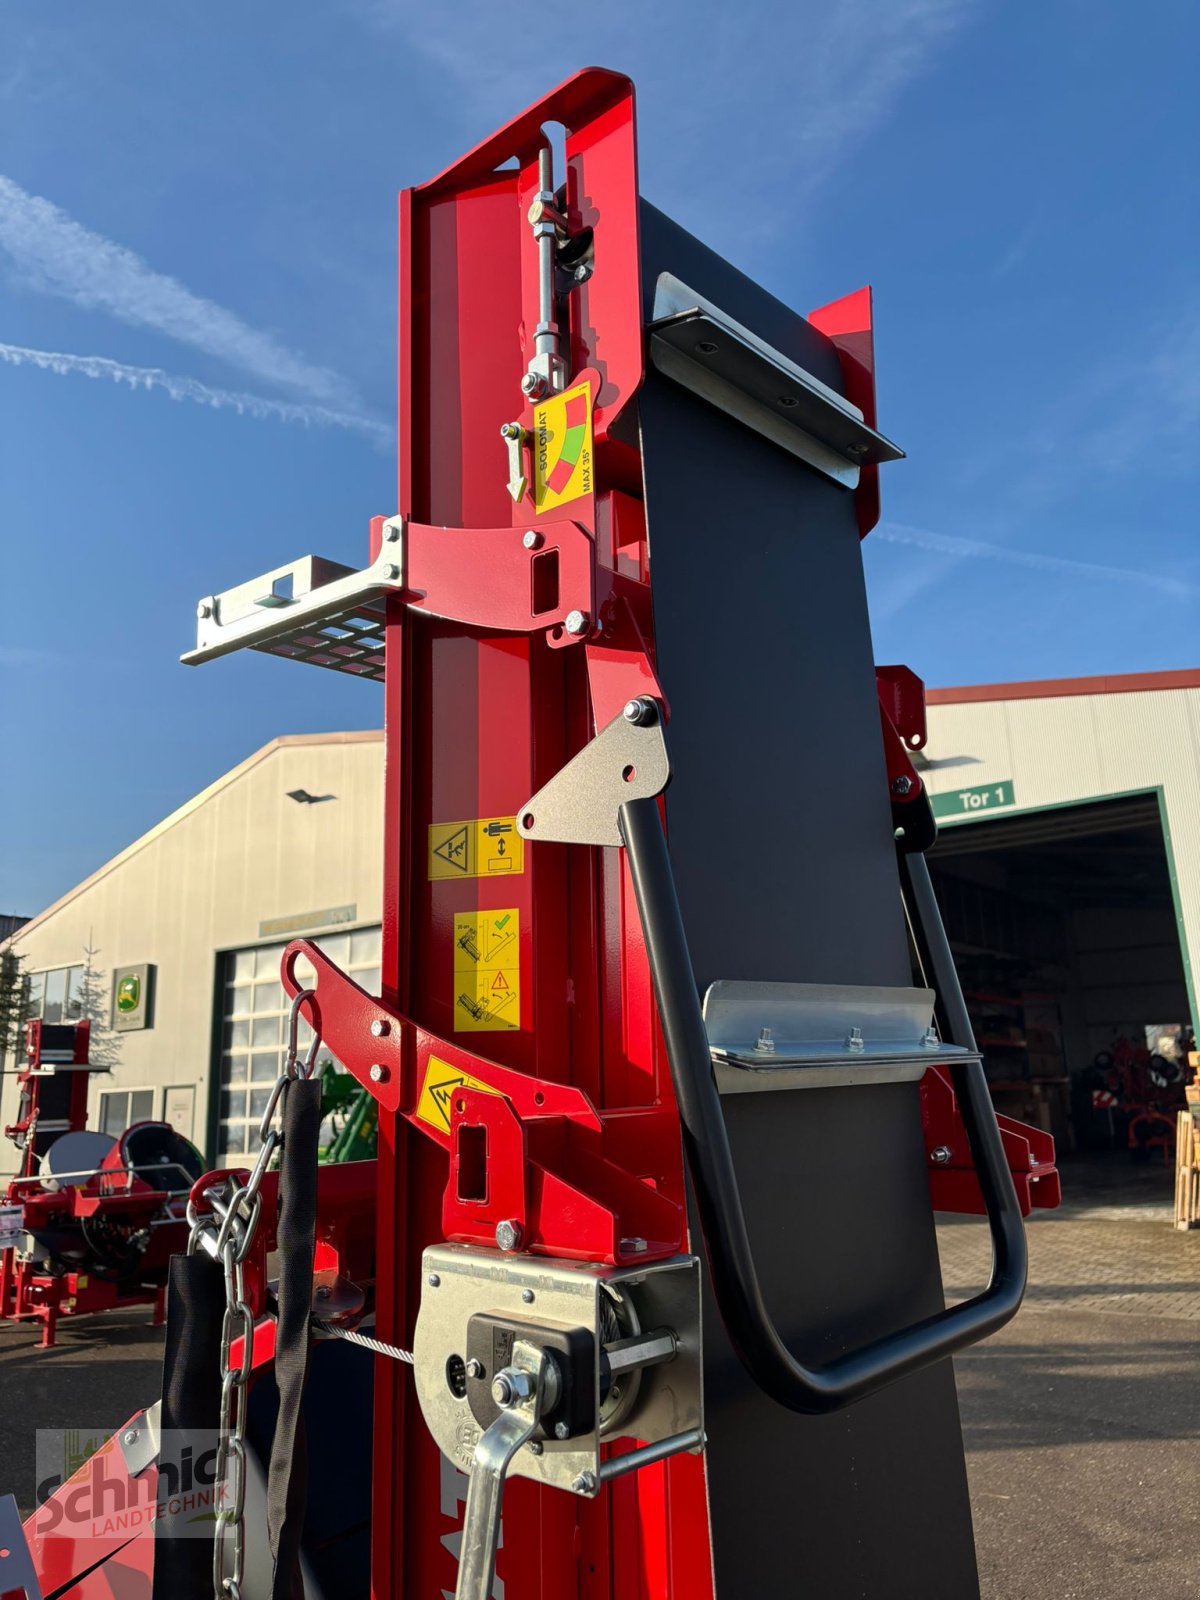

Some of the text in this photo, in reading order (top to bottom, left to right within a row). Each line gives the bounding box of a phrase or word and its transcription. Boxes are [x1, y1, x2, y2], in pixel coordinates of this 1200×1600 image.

[539, 412, 548, 471] SOLOMAT
[582, 448, 590, 465] 35°
[959, 787, 1004, 811] Tor 1
